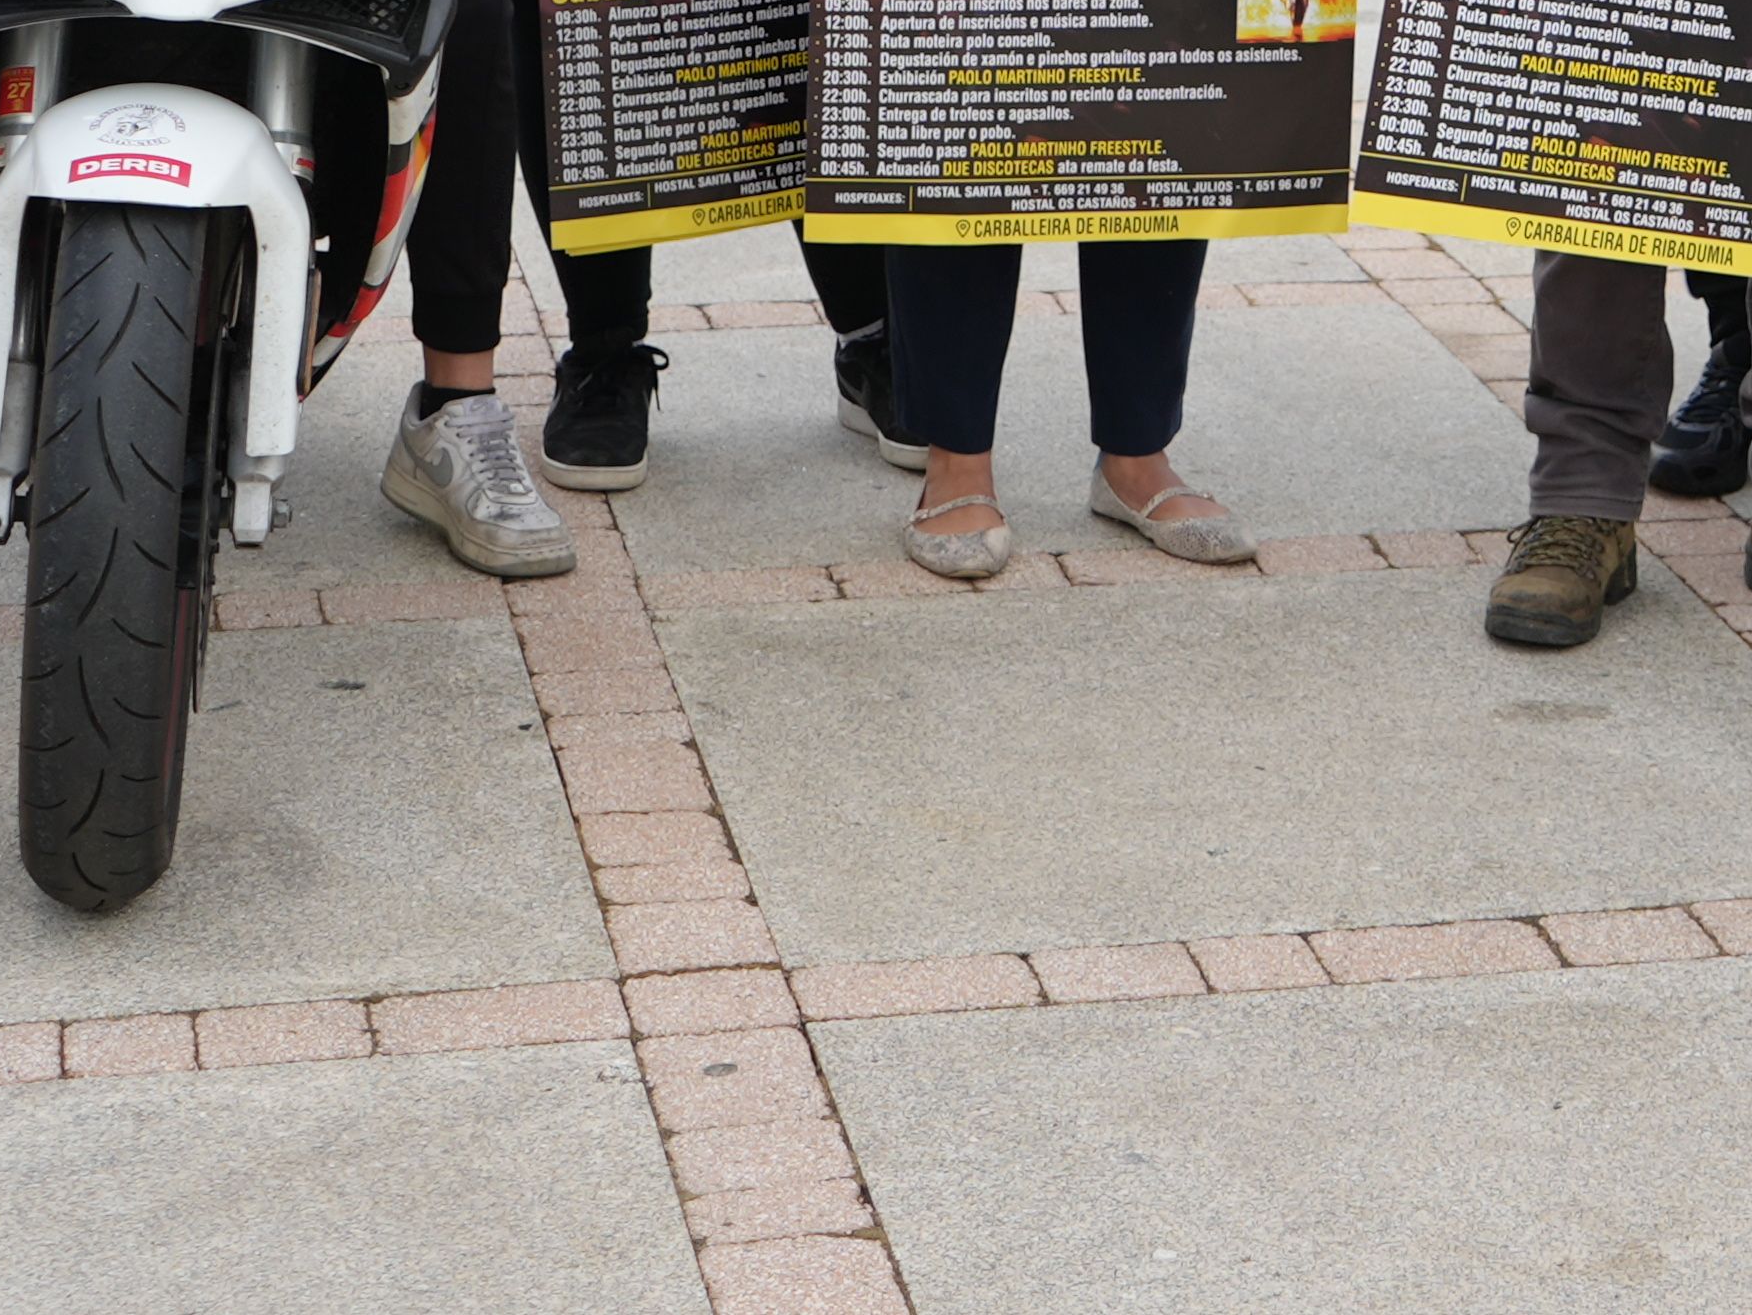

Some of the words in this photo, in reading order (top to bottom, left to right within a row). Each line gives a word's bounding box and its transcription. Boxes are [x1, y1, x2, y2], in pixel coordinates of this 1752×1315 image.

[824, 34, 872, 48] 17:30h.
[880, 34, 909, 48] Ruta
[914, 34, 963, 48] moteira
[966, 34, 994, 51] polo
[998, 33, 1055, 48] concello.
[7, 81, 31, 100] 27
[1384, 76, 1436, 98] 23:00h.
[1442, 83, 1494, 109] Entrega
[1496, 92, 1513, 108] de
[1515, 94, 1562, 115] trofeos
[1563, 104, 1573, 116] e
[1575, 101, 1643, 130] agasallos.
[76, 157, 181, 178] DERBI
[974, 219, 1070, 237] CARBALLEIRA
[1076, 218, 1094, 234] DE
[1099, 215, 1179, 234] RIBADUMIA
